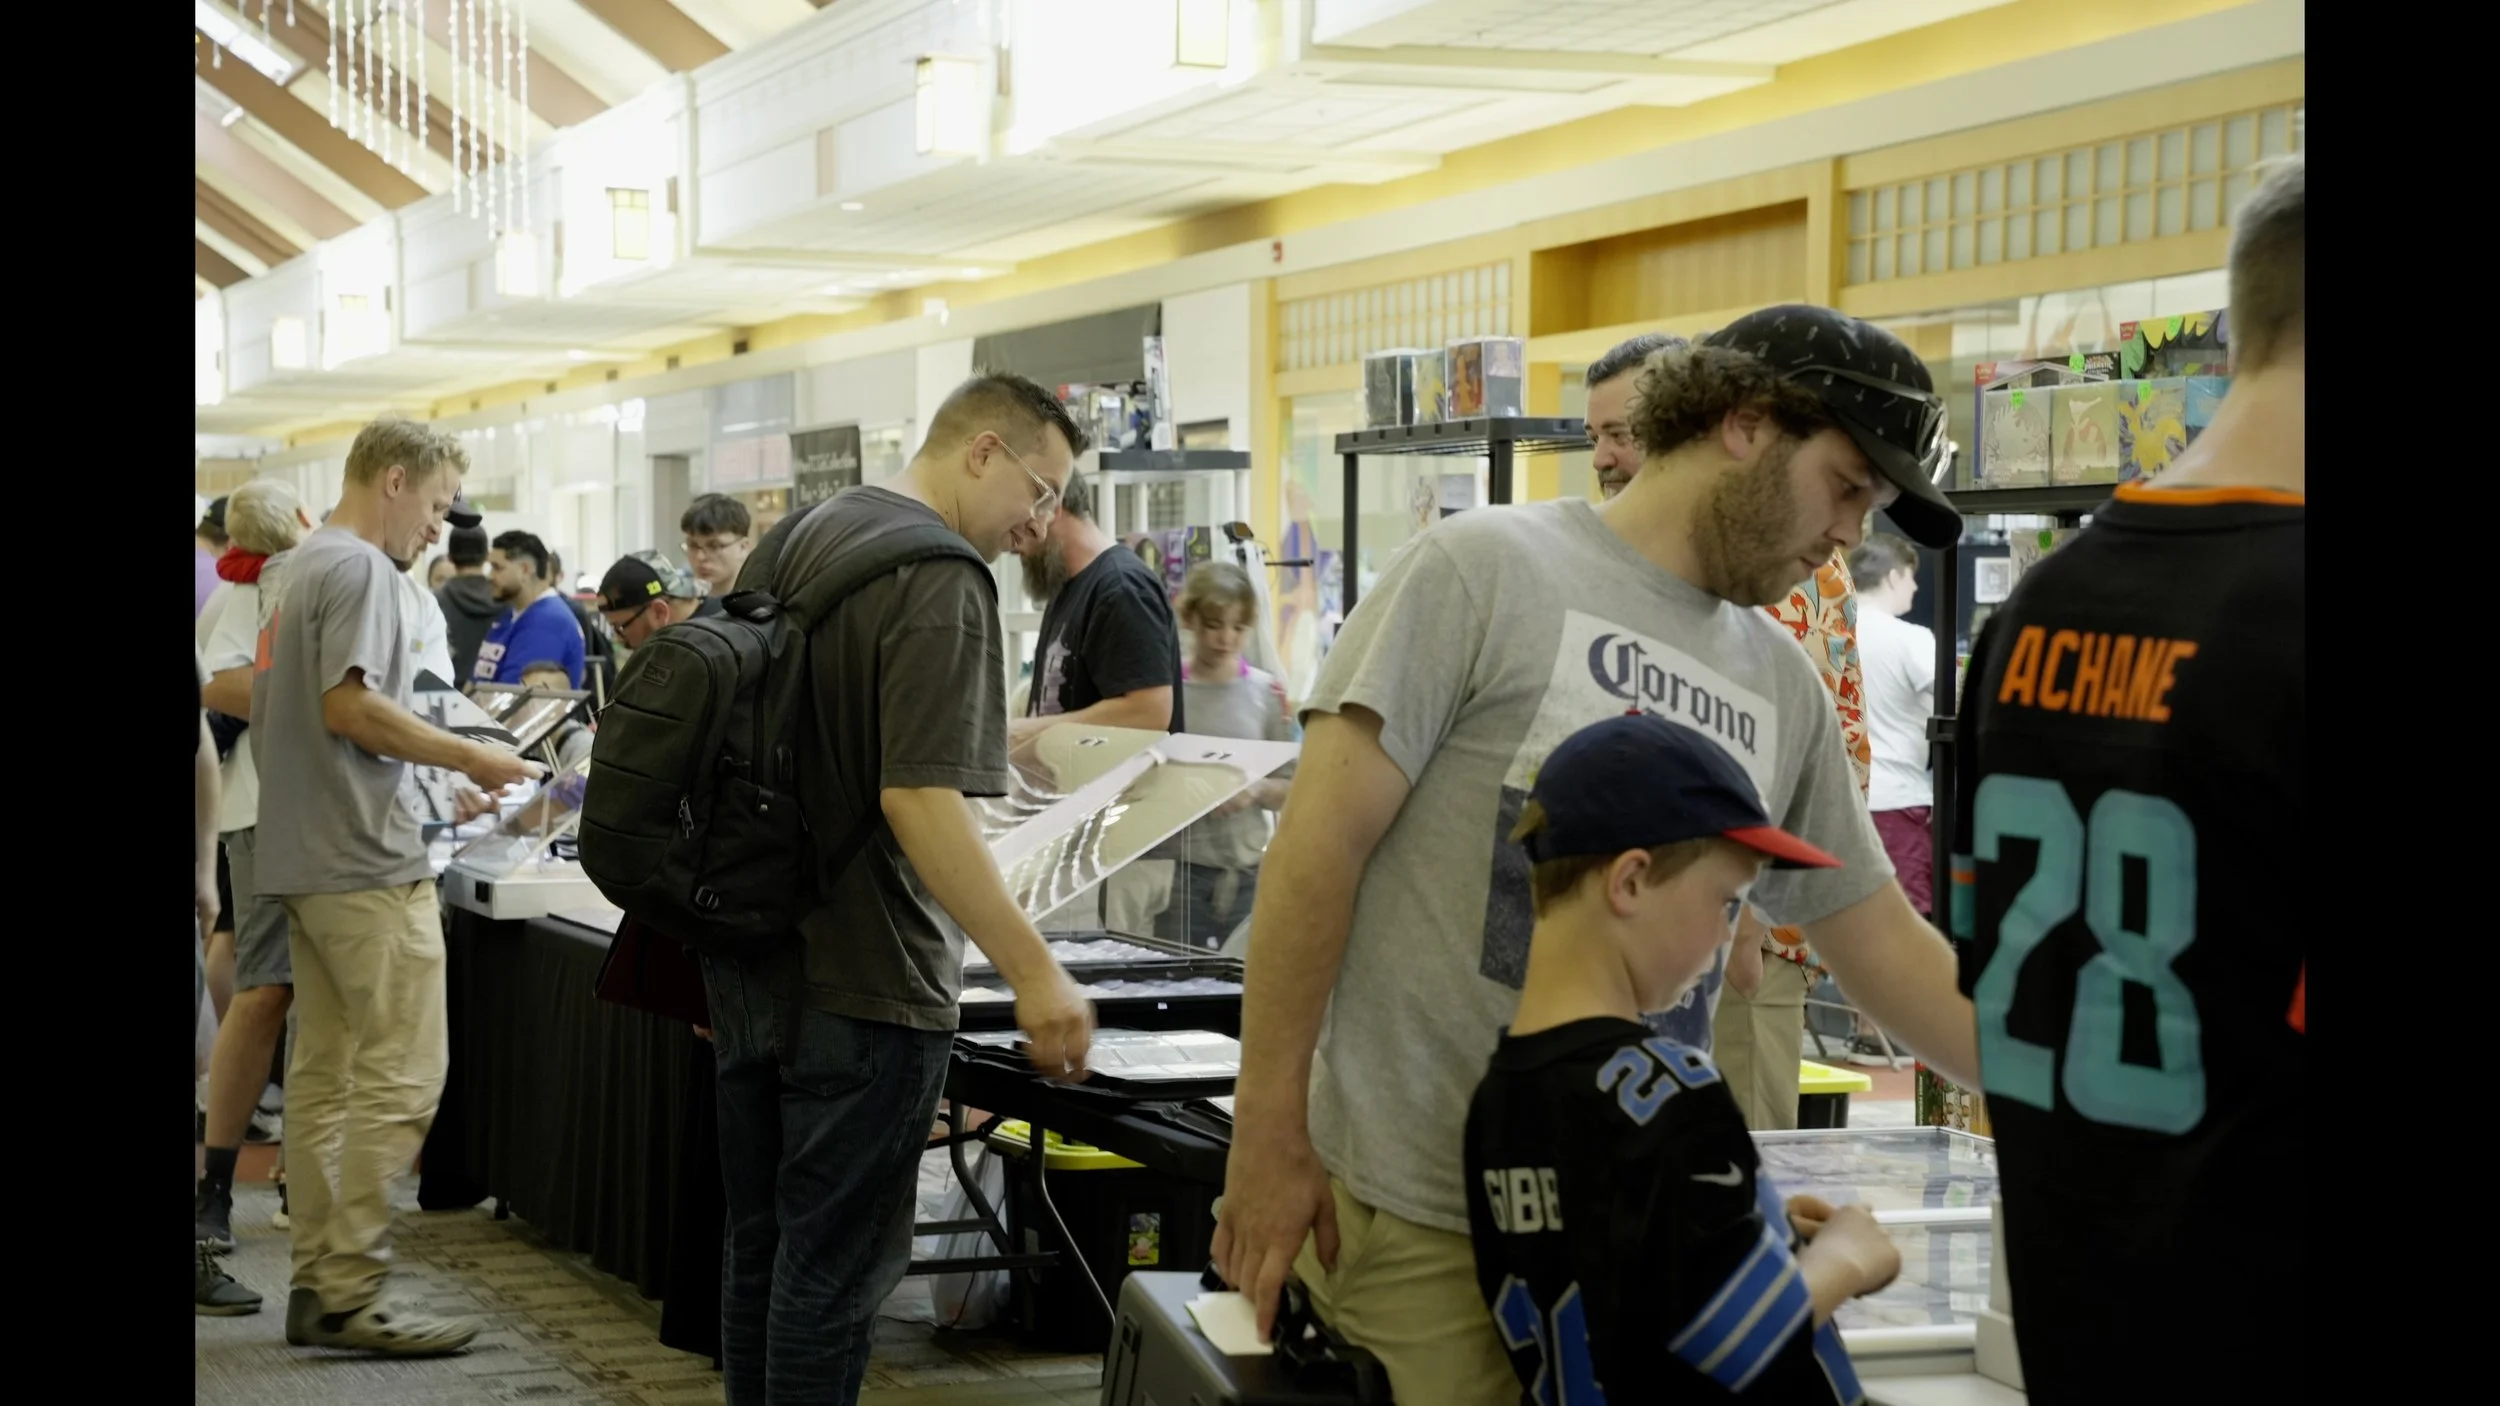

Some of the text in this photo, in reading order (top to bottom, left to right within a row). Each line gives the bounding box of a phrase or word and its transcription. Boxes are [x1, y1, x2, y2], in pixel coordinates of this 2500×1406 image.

[1588, 633, 1756, 755] Corona
[1998, 625, 2199, 723] ACHANE
[1973, 773, 2207, 1136] 28
